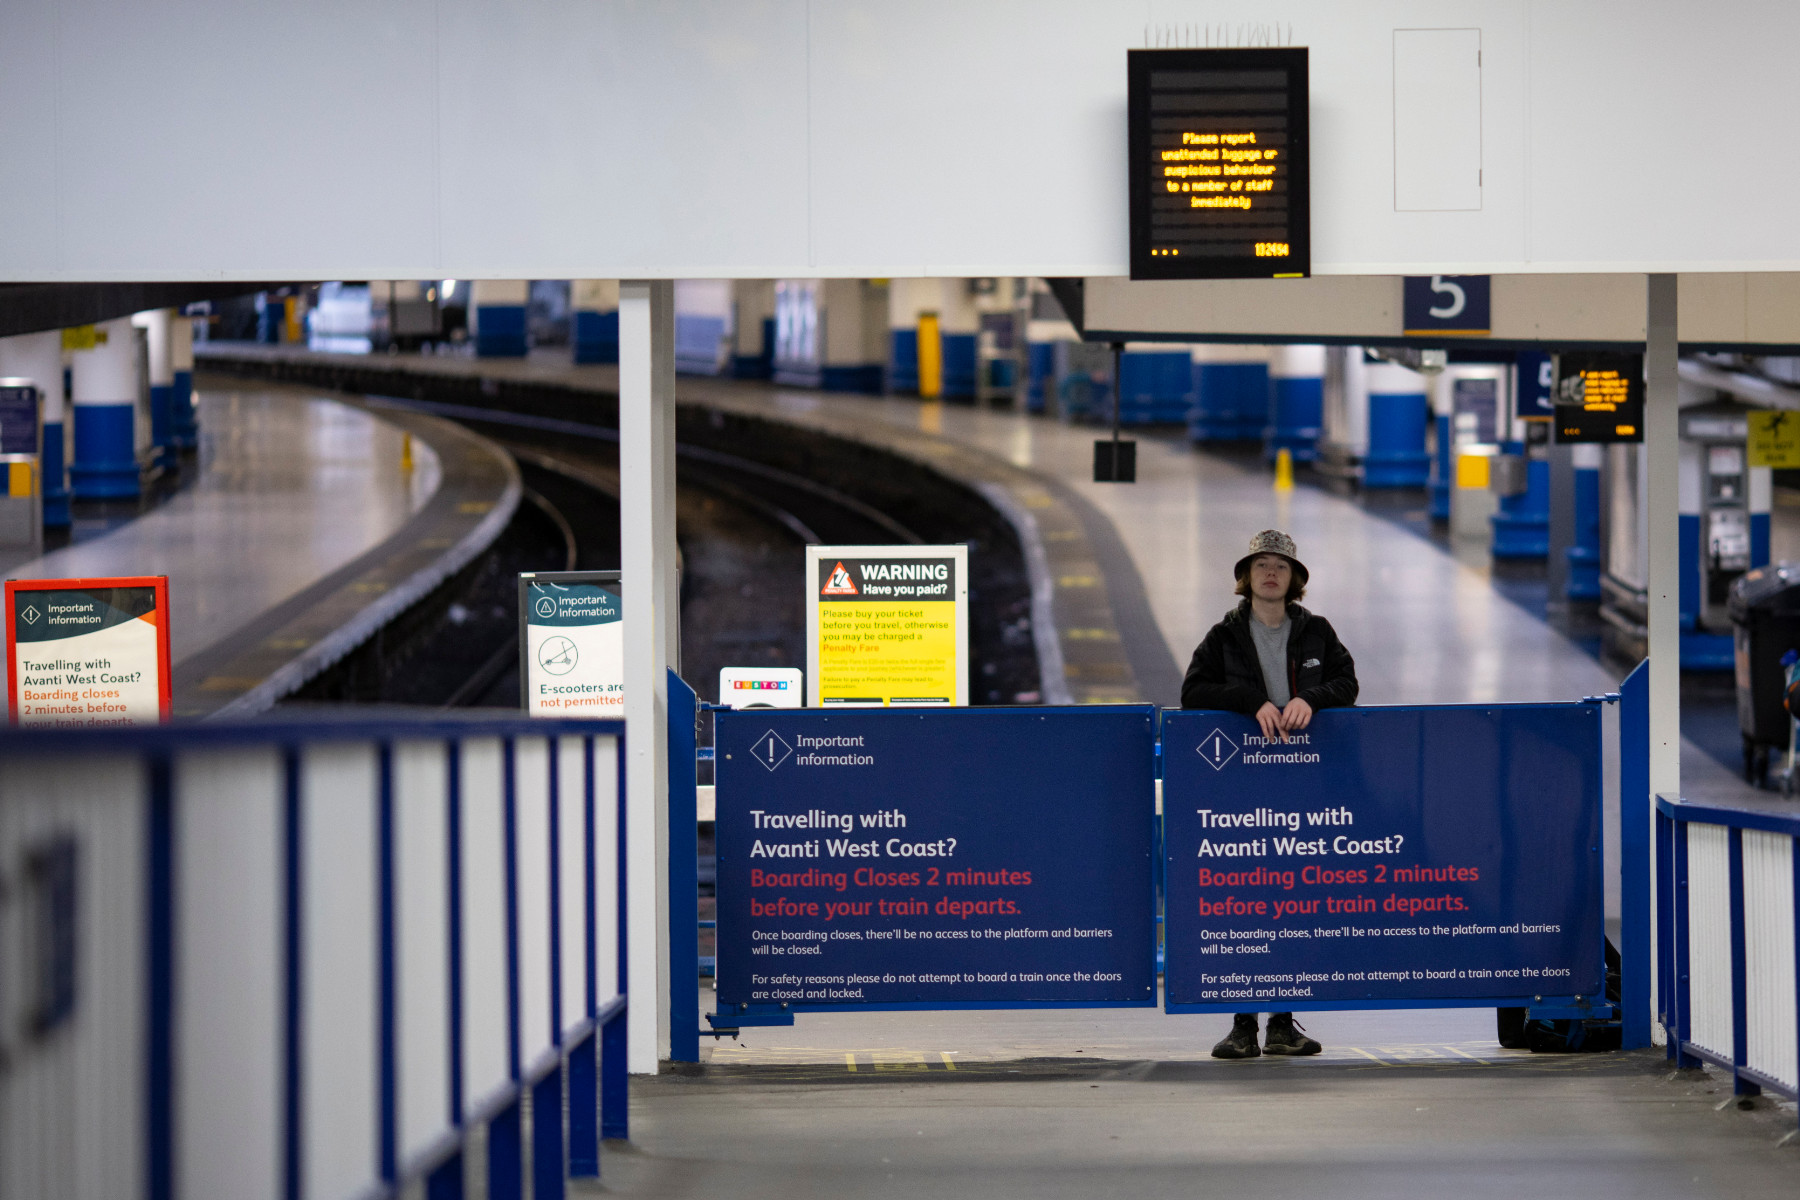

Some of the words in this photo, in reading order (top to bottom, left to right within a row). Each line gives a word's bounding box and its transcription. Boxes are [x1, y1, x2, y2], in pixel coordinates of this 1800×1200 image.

[1183, 133, 1219, 144] Please
[1220, 132, 1256, 146] report
[1162, 149, 1219, 161] unattended
[1222, 148, 1262, 162] luggage
[1264, 150, 1278, 159] or
[1164, 164, 1222, 178] suspicious
[1224, 164, 1276, 175] behaviour
[1167, 181, 1180, 192] to
[1182, 182, 1190, 192] a
[1192, 180, 1228, 192] member
[1230, 180, 1243, 191] of
[1245, 179, 1273, 191] staff
[1191, 196, 1251, 209] immediately
[1428, 276, 1466, 318] 5
[861, 565, 948, 580] WARNING
[863, 584, 892, 594] Have
[894, 586, 914, 596] you
[917, 584, 947, 596] paid?
[558, 596, 606, 606] Important
[49, 604, 93, 614] Important
[558, 607, 616, 618] Information
[856, 611, 872, 619] buy
[48, 615, 102, 624] information
[875, 622, 902, 630] travel,
[878, 633, 914, 641] charged
[824, 644, 857, 653] Penalty
[858, 644, 880, 653] Fare
[23, 660, 81, 672] Travelling
[85, 659, 110, 669] with
[24, 675, 61, 685] Avanti
[66, 675, 96, 684] West
[101, 672, 141, 683] Coast?
[25, 690, 78, 701] Boarding
[82, 688, 119, 698] closes
[541, 684, 603, 694] E-scooters
[24, 705, 32, 714] 2
[34, 704, 84, 714] minutes
[87, 702, 127, 713] before
[541, 698, 560, 707] not
[565, 695, 623, 708] permitted
[797, 735, 864, 750] Important
[1243, 733, 1310, 748] Imporant
[797, 753, 873, 765] information
[1244, 752, 1319, 764] information
[750, 810, 853, 833] Travelling
[860, 809, 906, 827] with
[1197, 808, 1300, 831] Travelling
[1307, 807, 1352, 825] with
[750, 840, 819, 857] Avanti
[826, 839, 880, 857] West
[886, 838, 957, 857] Coast?
[1198, 839, 1266, 857] Avanti
[1273, 837, 1328, 855] West
[1334, 835, 1403, 854] Coast?
[752, 868, 847, 891] Boarding
[854, 868, 920, 886] Closes
[927, 867, 939, 885] 2
[947, 868, 1032, 885] minutes
[1199, 867, 1294, 890] Boarding
[1302, 866, 1367, 884] Closes
[1374, 865, 1386, 883] 2
[1394, 865, 1479, 882] minutes
[752, 898, 819, 916] before
[825, 903, 872, 921] your
[879, 898, 928, 915] train
[936, 897, 1021, 919] departs.
[1200, 896, 1267, 916] before
[1273, 900, 1320, 919] your
[1326, 895, 1376, 913] train
[1383, 894, 1469, 916] departs.
[752, 931, 778, 940] Once
[782, 930, 827, 942] boarding
[831, 930, 863, 940] closes,
[904, 929, 916, 939] be
[971, 930, 981, 938] to
[984, 928, 1001, 938] the
[1005, 928, 1048, 940] platform
[1051, 928, 1071, 938] and
[1074, 928, 1112, 937] barriers
[1201, 930, 1227, 939] Once
[1230, 929, 1276, 940] boarding
[1279, 928, 1311, 938] closes,
[1352, 927, 1365, 936] be
[1419, 927, 1430, 935] to
[1433, 925, 1449, 935] the
[1453, 924, 1496, 937] platform
[1500, 924, 1519, 933] and
[1522, 924, 1560, 933] barriers
[752, 945, 768, 954] will
[772, 945, 784, 954] be
[787, 945, 822, 954] closed.
[1201, 944, 1217, 954] will
[1221, 944, 1233, 954] be
[1236, 943, 1270, 953] closed.
[753, 975, 768, 984] For
[771, 974, 802, 986] safety
[848, 974, 880, 986] please
[883, 973, 896, 983] do
[899, 974, 916, 982] not
[919, 974, 961, 984] attempt
[964, 974, 974, 982] to
[978, 972, 1007, 982] board
[1020, 973, 1043, 981] train
[1073, 971, 1090, 981] the
[1093, 971, 1121, 981] doors
[1202, 974, 1217, 983] For
[1220, 973, 1251, 985] safety
[1296, 972, 1329, 984] please
[1332, 971, 1345, 981] do
[1348, 972, 1365, 980] not
[1368, 971, 1410, 982] attempt
[1413, 971, 1423, 979] to
[1427, 969, 1456, 979] board
[1468, 969, 1492, 978] train
[1522, 967, 1539, 977] the
[1542, 967, 1570, 976] doors
[772, 989, 803, 998] closed
[807, 989, 826, 998] and
[830, 988, 864, 998] locked.
[1221, 988, 1253, 997] closed
[1256, 987, 1275, 997] and
[1279, 987, 1313, 996] locked.
